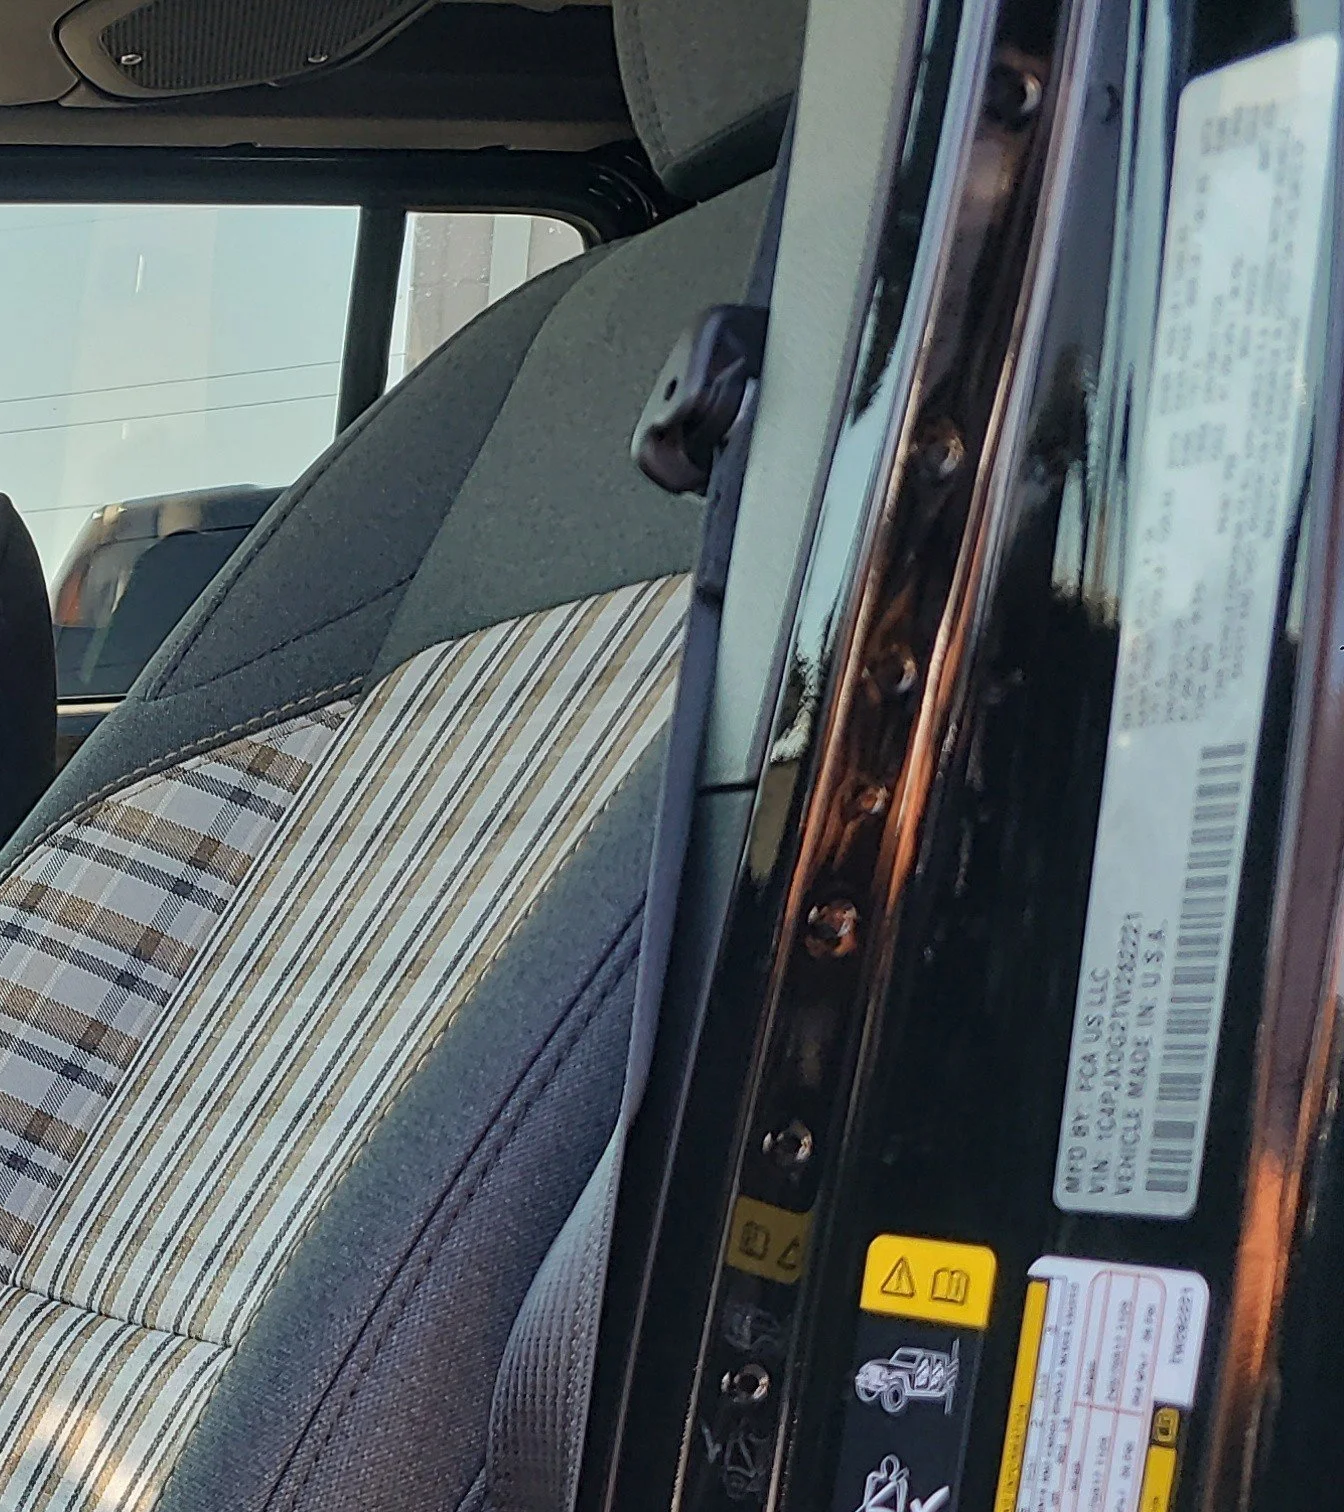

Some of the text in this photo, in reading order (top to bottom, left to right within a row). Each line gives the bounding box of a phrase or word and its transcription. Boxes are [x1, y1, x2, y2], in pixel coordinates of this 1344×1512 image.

[1086, 967, 1110, 1007] LLC
[1081, 1014, 1104, 1043] US
[1076, 1053, 1099, 1092] FCA
[1127, 1035, 1153, 1098] MADE
[1065, 1146, 1087, 1193] MFD
[1112, 1108, 1143, 1195] VEHICLE
